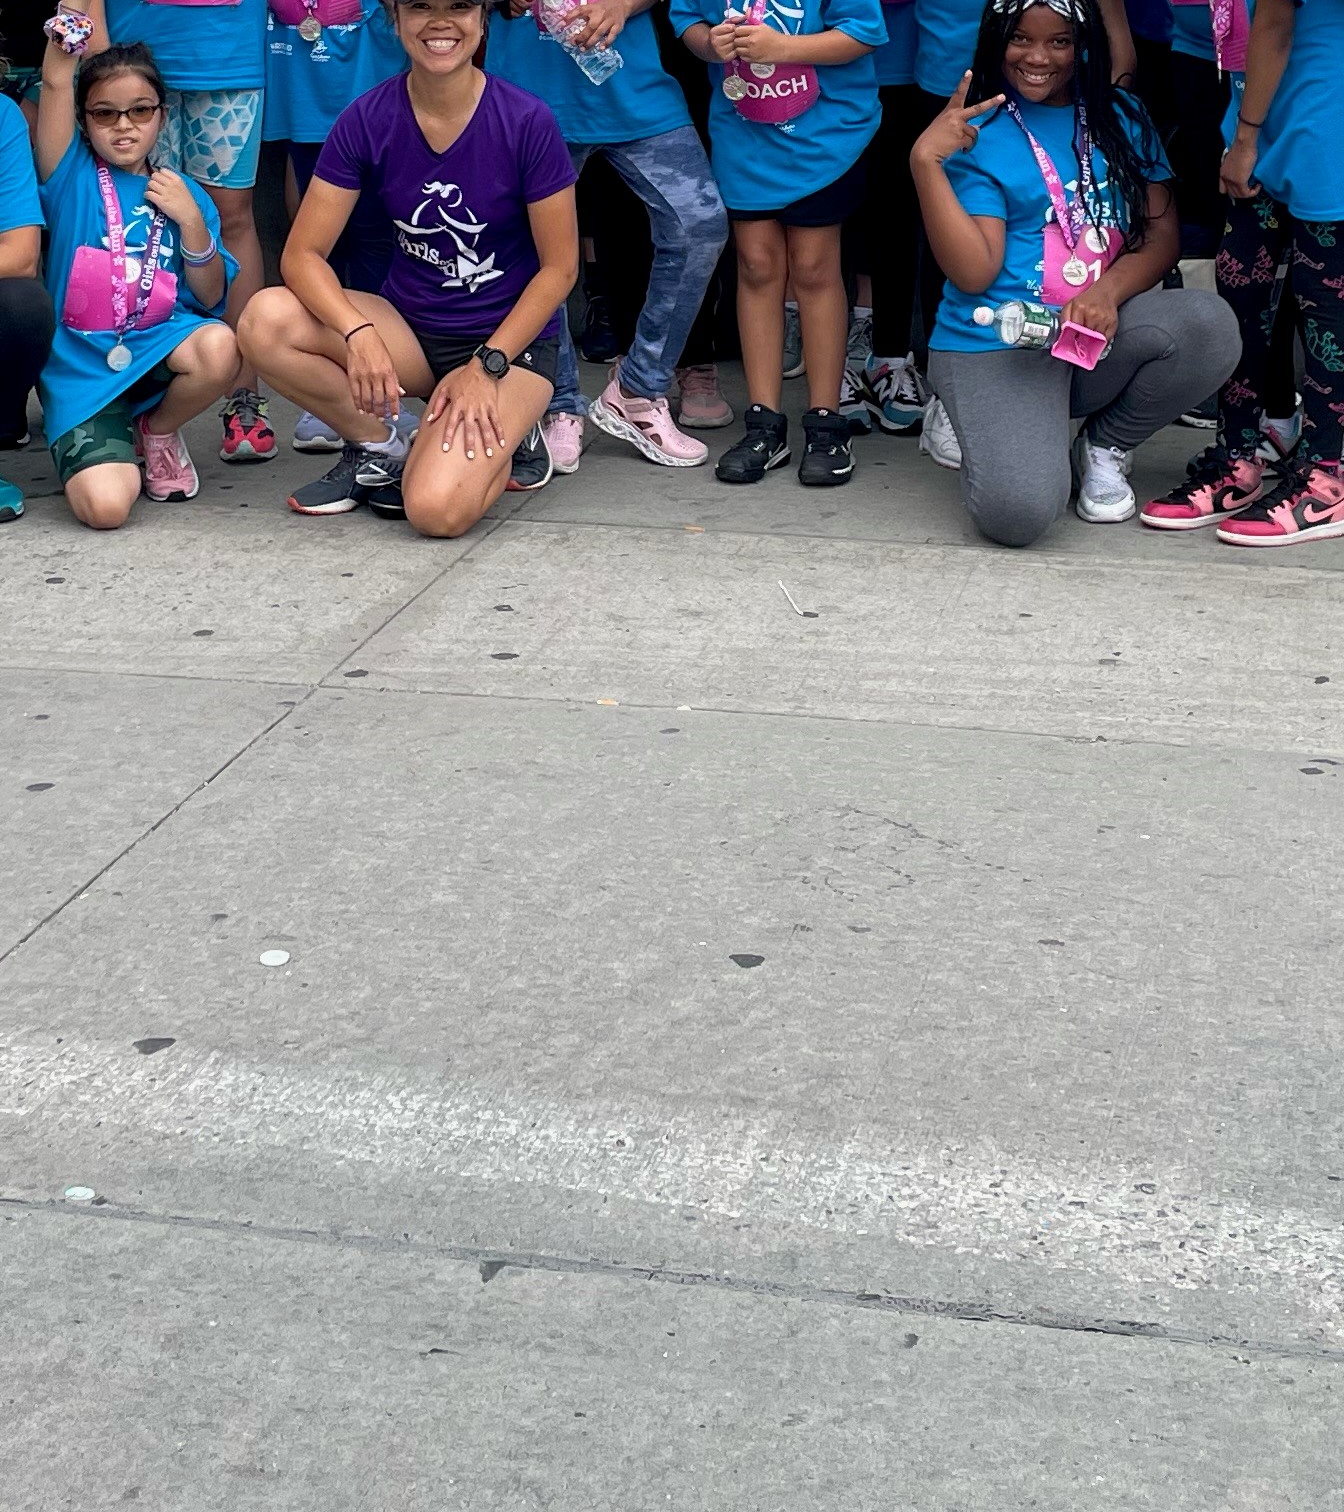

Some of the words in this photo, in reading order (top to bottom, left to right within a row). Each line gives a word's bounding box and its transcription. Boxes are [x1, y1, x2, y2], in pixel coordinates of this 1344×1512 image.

[746, 74, 809, 100] OACH
[109, 223, 123, 253] Run
[1087, 259, 1103, 282] 1
